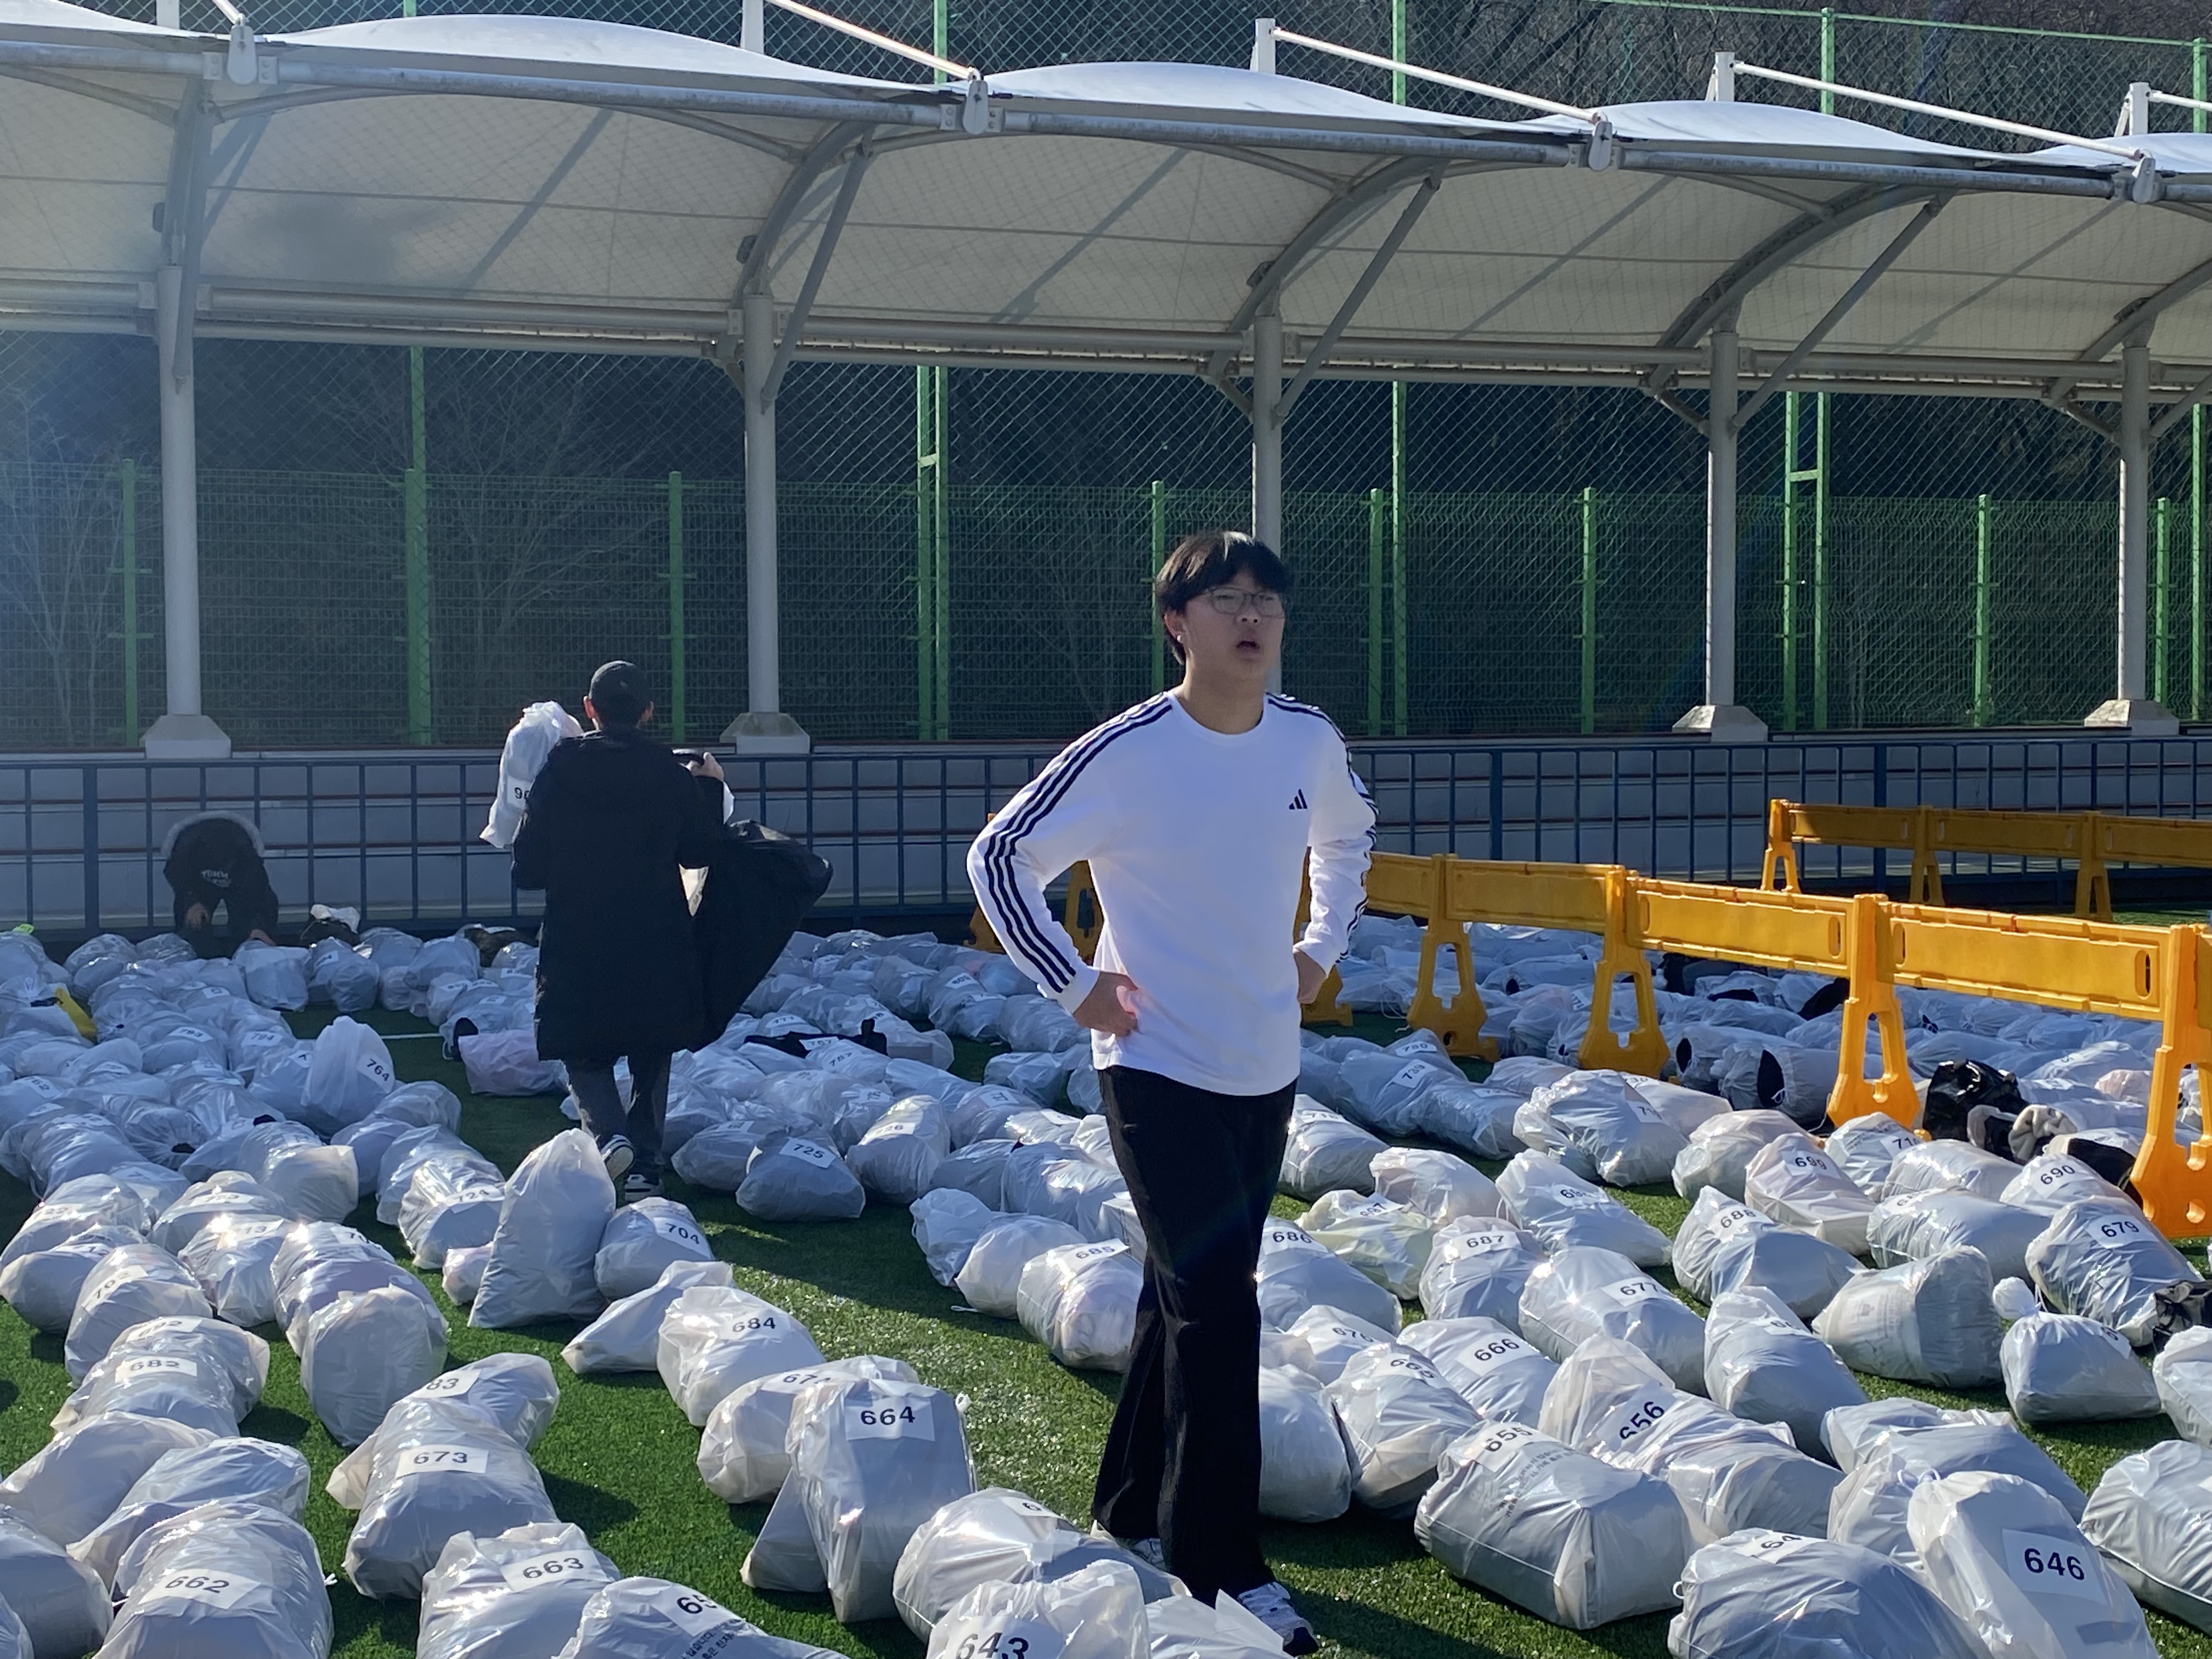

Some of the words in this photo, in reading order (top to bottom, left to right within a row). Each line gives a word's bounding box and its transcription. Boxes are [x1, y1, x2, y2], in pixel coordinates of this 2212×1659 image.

[366, 1058, 390, 1081] 764
[793, 1143, 825, 1159] 725
[2040, 1165, 2075, 1184] 690
[665, 1223, 699, 1245] 704
[1273, 1231, 1312, 1244] 686
[2101, 1221, 2140, 1238] 679
[1466, 1235, 1504, 1248] 687
[1620, 1282, 1658, 1296] 677
[732, 1317, 776, 1333] 684
[1474, 1339, 1520, 1361] 666
[426, 1378, 459, 1390] 83
[861, 1406, 916, 1425] 664
[1619, 1401, 1665, 1441] 656
[1484, 1426, 1532, 1452] 655
[414, 1451, 468, 1464] 673
[523, 1558, 584, 1579] 663
[2024, 1548, 2084, 1581] 646
[165, 1575, 229, 1593] 662
[956, 1632, 1030, 1659] 643
